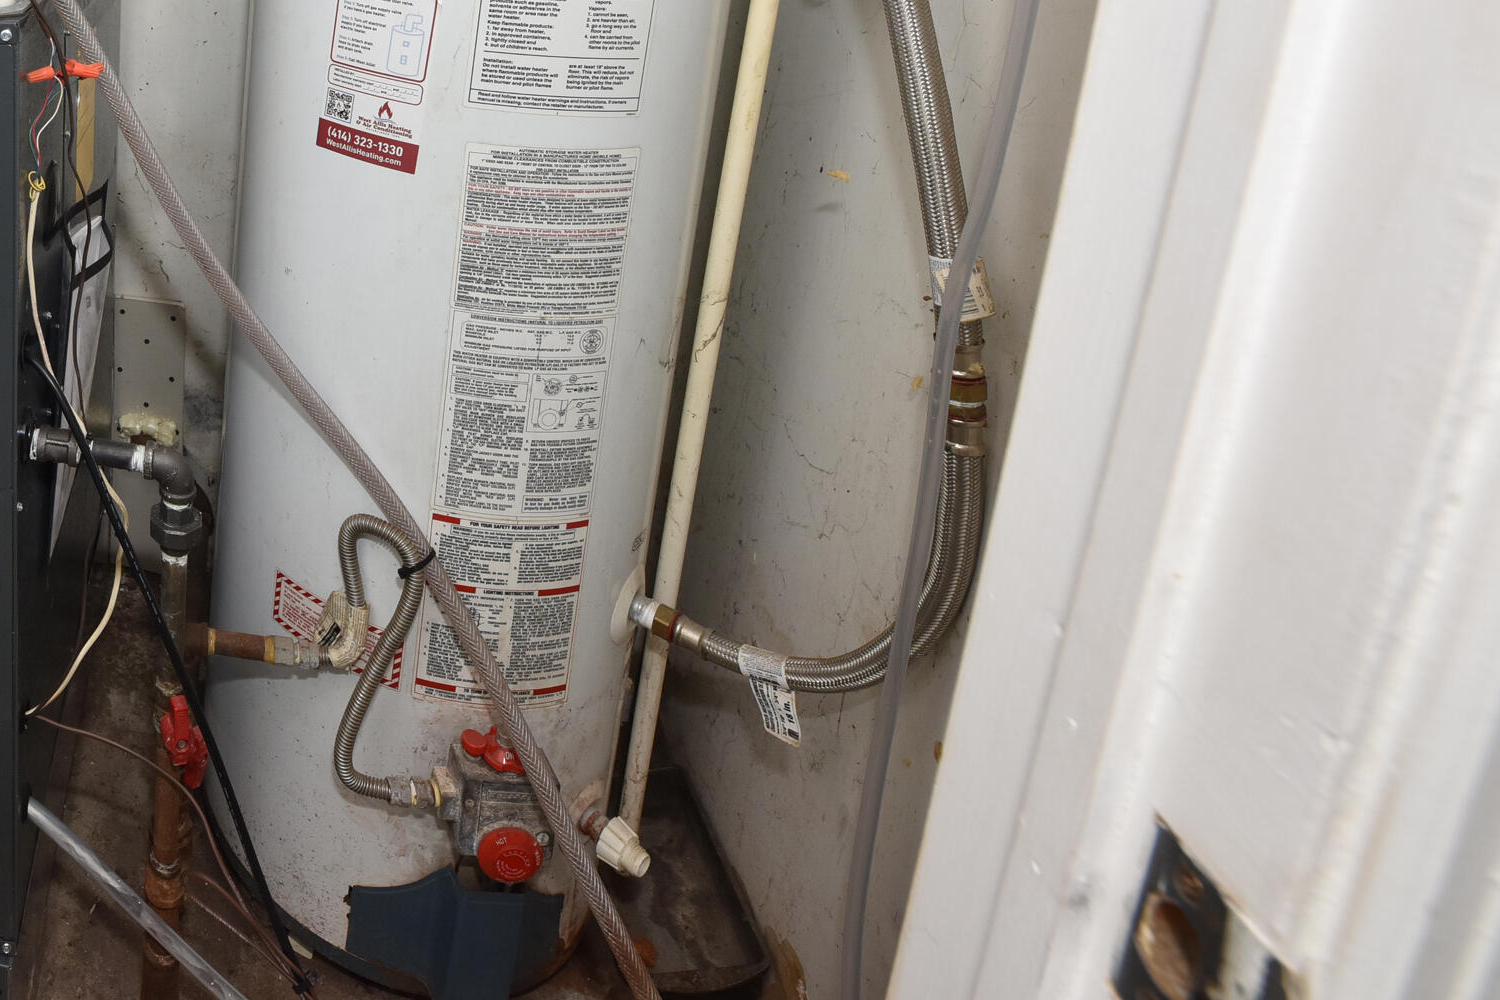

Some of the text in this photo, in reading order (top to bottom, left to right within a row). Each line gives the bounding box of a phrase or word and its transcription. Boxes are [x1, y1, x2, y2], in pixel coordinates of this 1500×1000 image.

[358, 116, 412, 134] West Allis Heating
[373, 125, 412, 139] Conditioning
[327, 126, 403, 157] (414) 323-1330
[326, 138, 401, 166] WestAllisHeating.com
[496, 836, 507, 846] HOT
